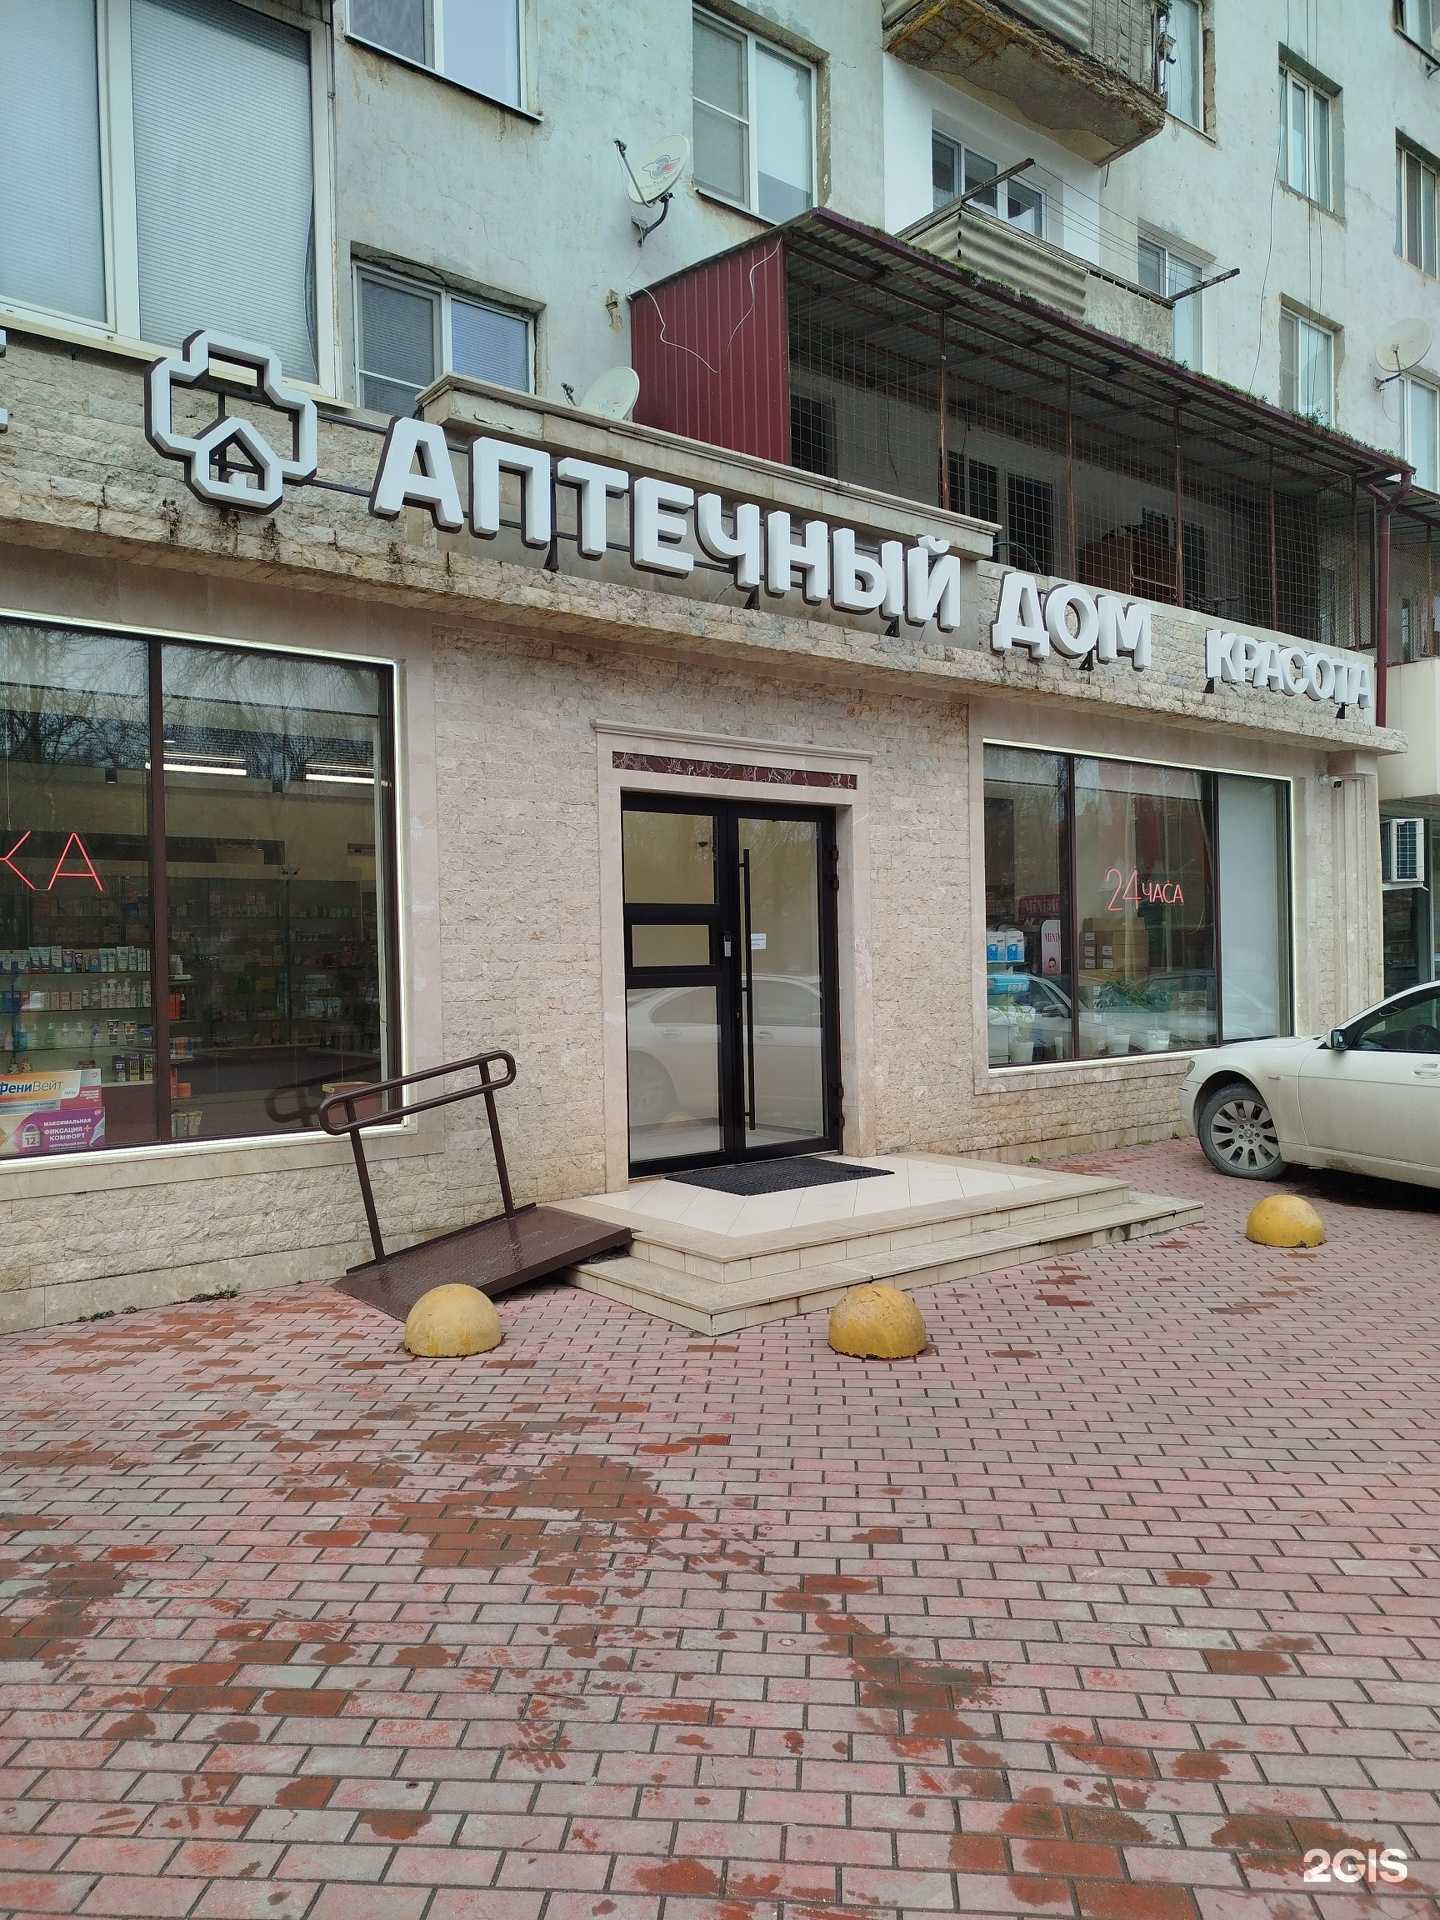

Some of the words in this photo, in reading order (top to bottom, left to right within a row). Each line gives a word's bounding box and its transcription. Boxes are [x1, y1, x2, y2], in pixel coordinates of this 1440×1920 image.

[370, 416, 960, 632] АПТЕЧНЫЙ
[991, 571, 1151, 671] ДОМ
[1205, 629, 1371, 709] КРАСОТА
[1104, 867, 1141, 911] 24
[1142, 882, 1184, 903] ЧАСА
[49, 1132, 85, 1141] КОМФОРТ
